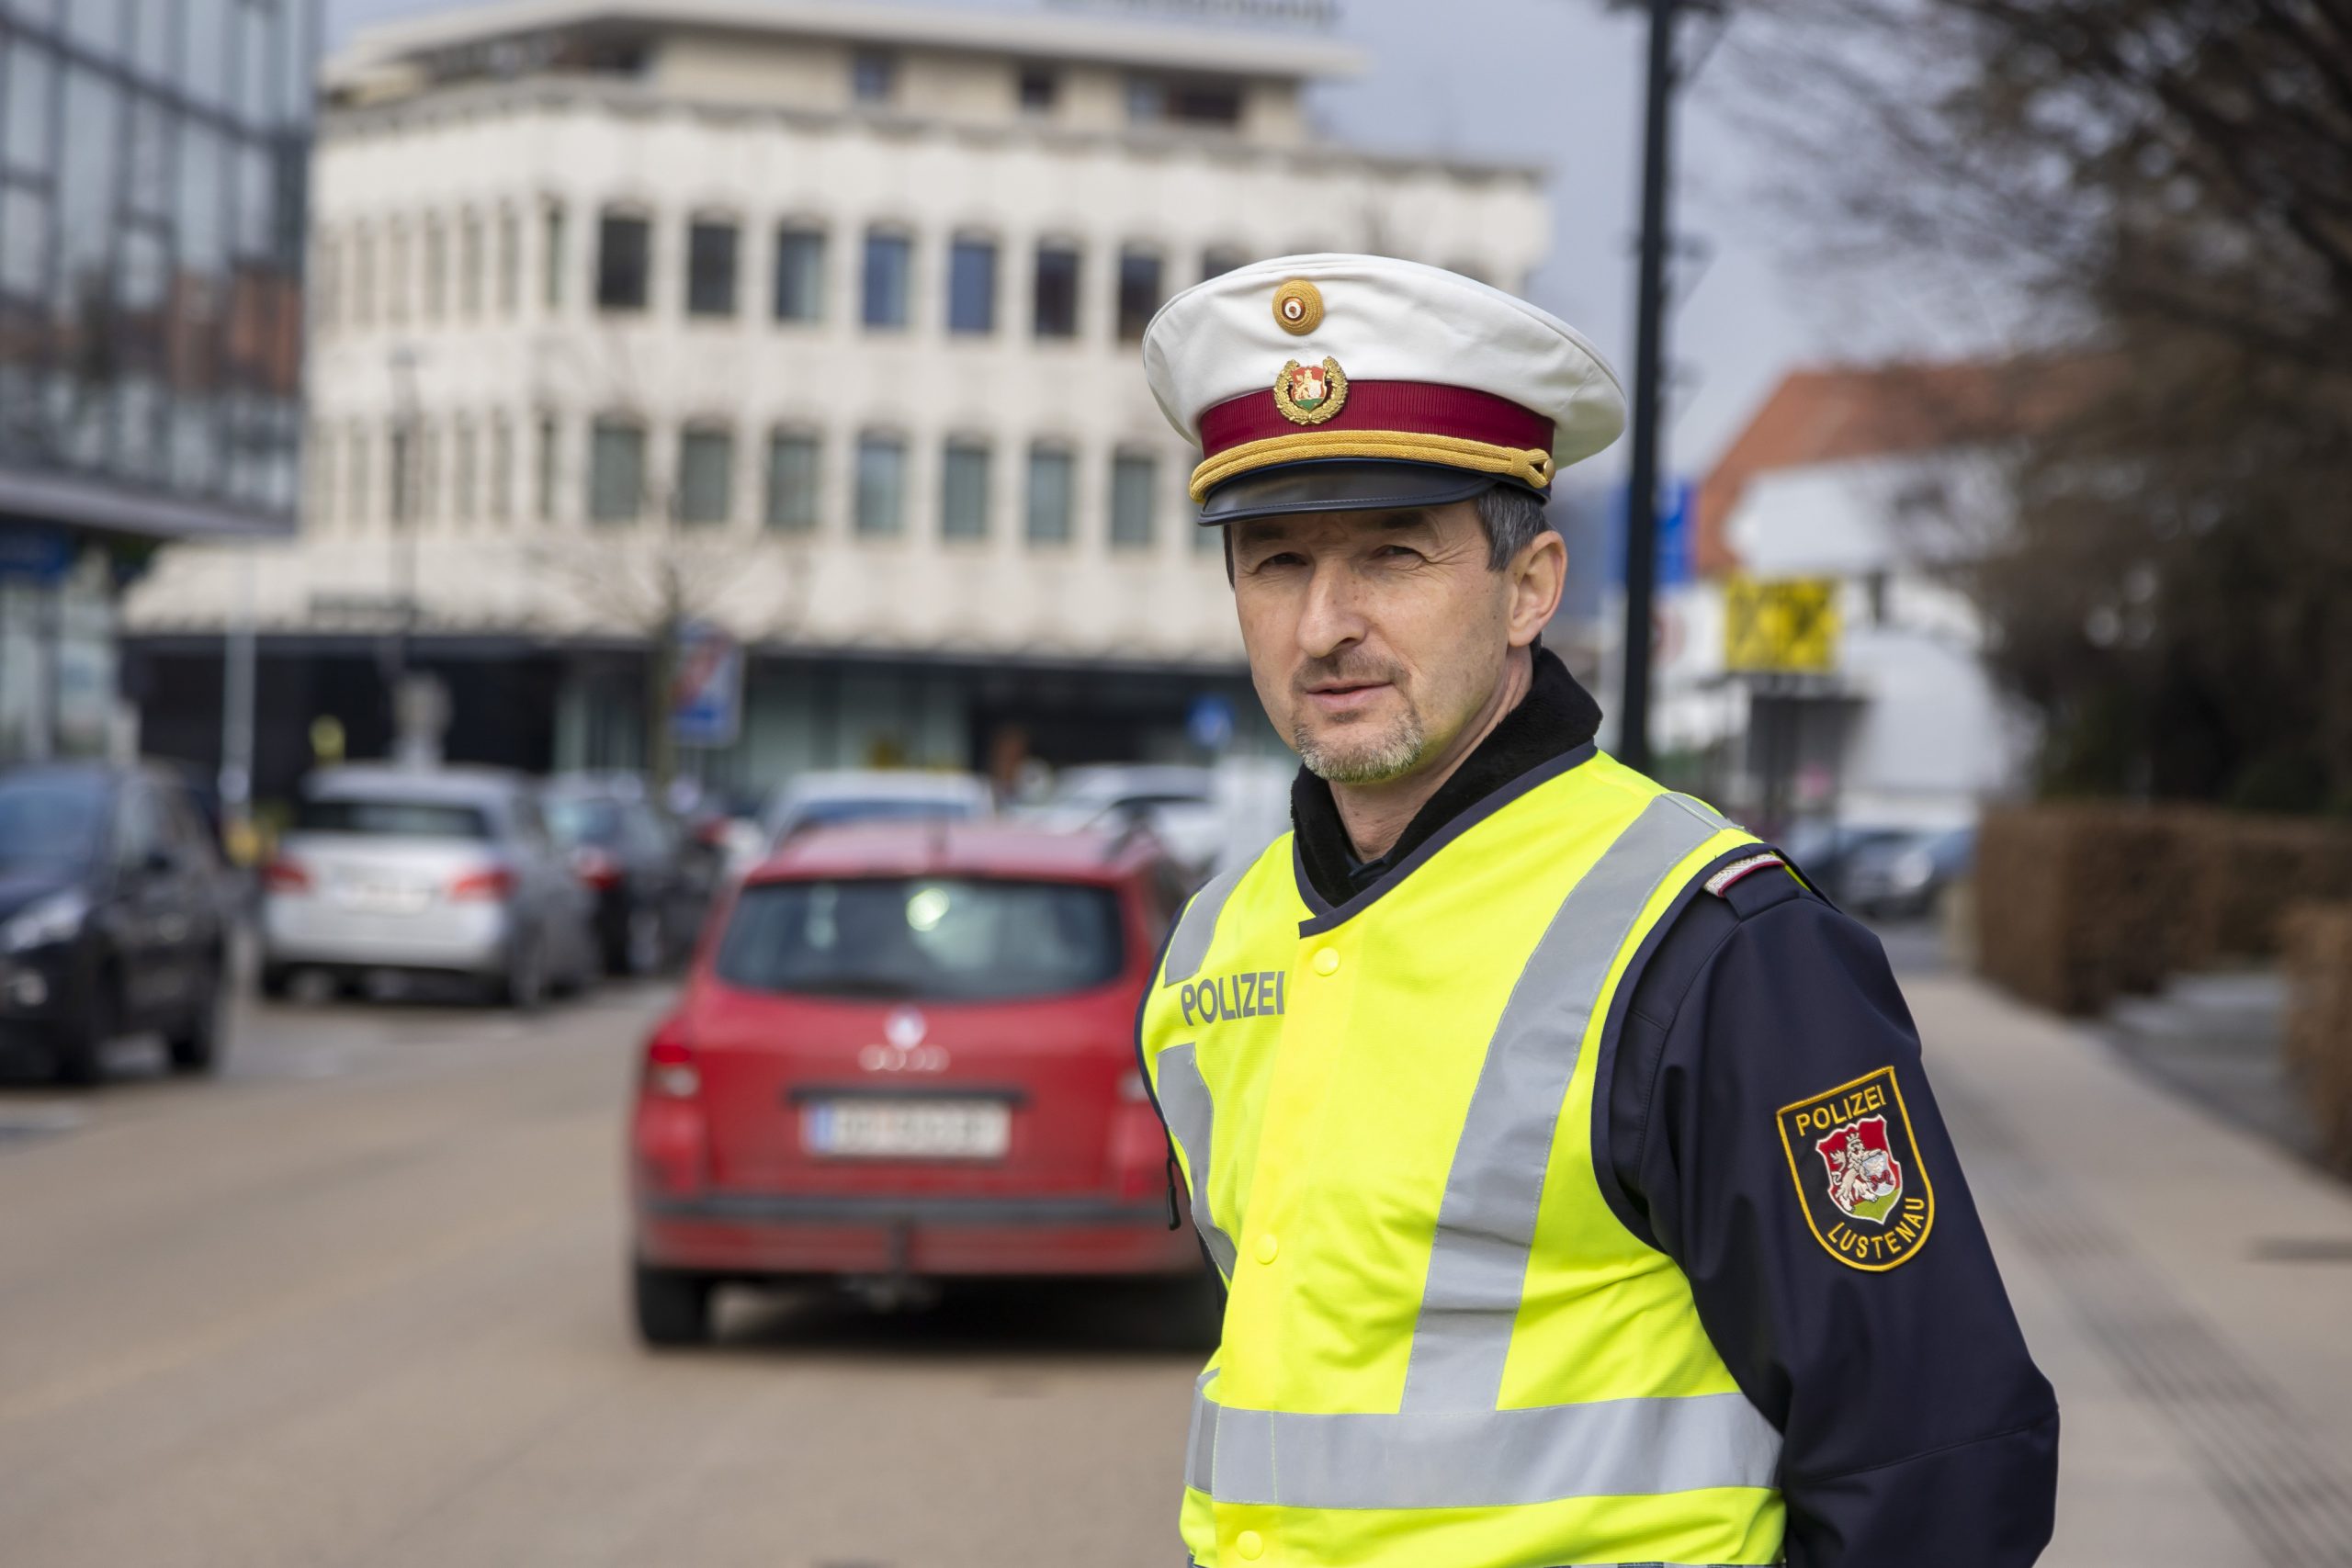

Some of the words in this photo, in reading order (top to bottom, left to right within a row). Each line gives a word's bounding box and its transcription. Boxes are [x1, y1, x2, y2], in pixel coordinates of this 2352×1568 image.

[1182, 971, 1285, 1026] POLIZEI
[1795, 1085, 1886, 1136] POLIZEI
[1827, 1197, 1925, 1258] LUSTENAU
